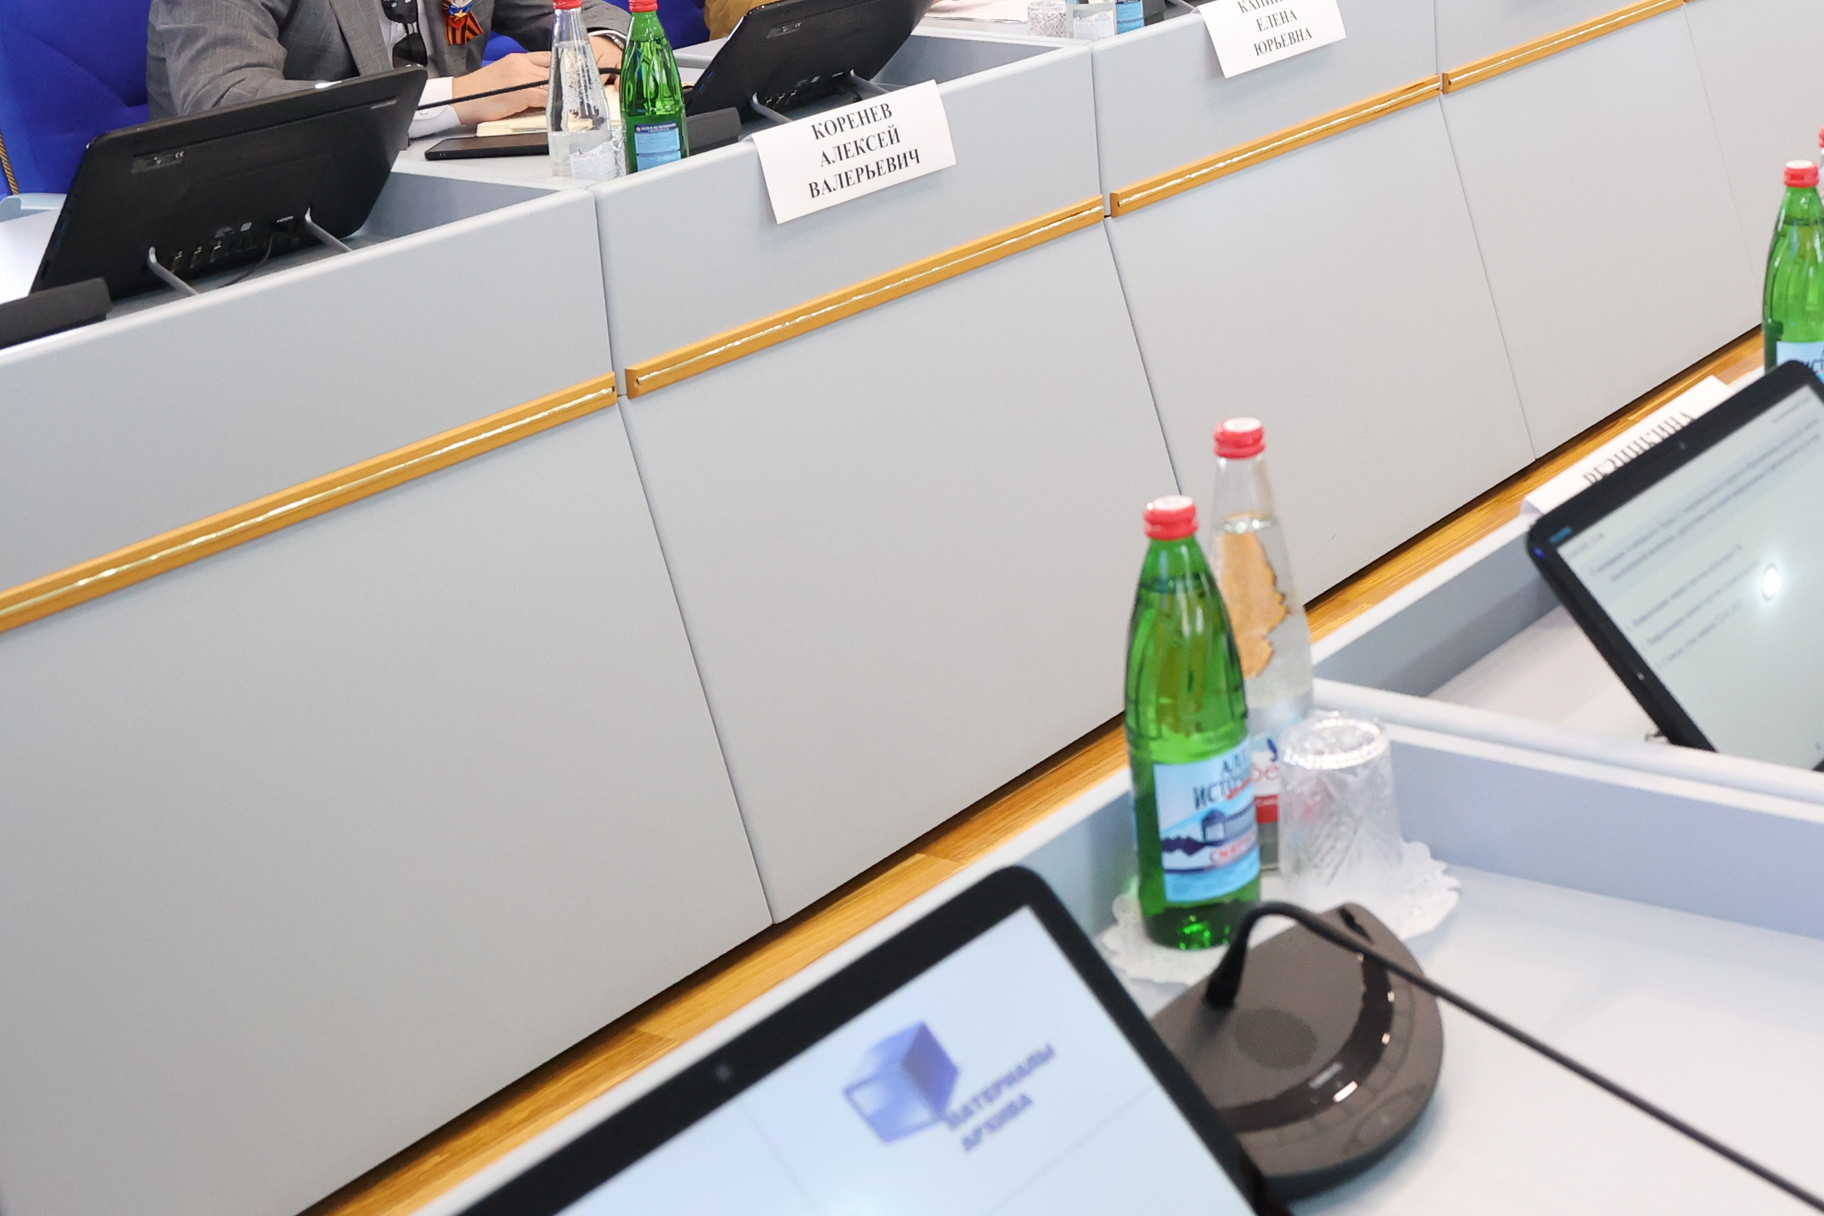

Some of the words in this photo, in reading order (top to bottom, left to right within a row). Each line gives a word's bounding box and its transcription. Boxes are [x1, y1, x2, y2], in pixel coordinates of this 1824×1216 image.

[1256, 9, 1298, 32] ЕЛЕНА
[1254, 27, 1313, 56] ЮРЬЕВНА
[811, 103, 893, 141] КОРЕНЕВ
[820, 124, 901, 167] АЛЕКСЕЙ
[808, 149, 921, 199] ВАЛЕРЬЕВИЧ
